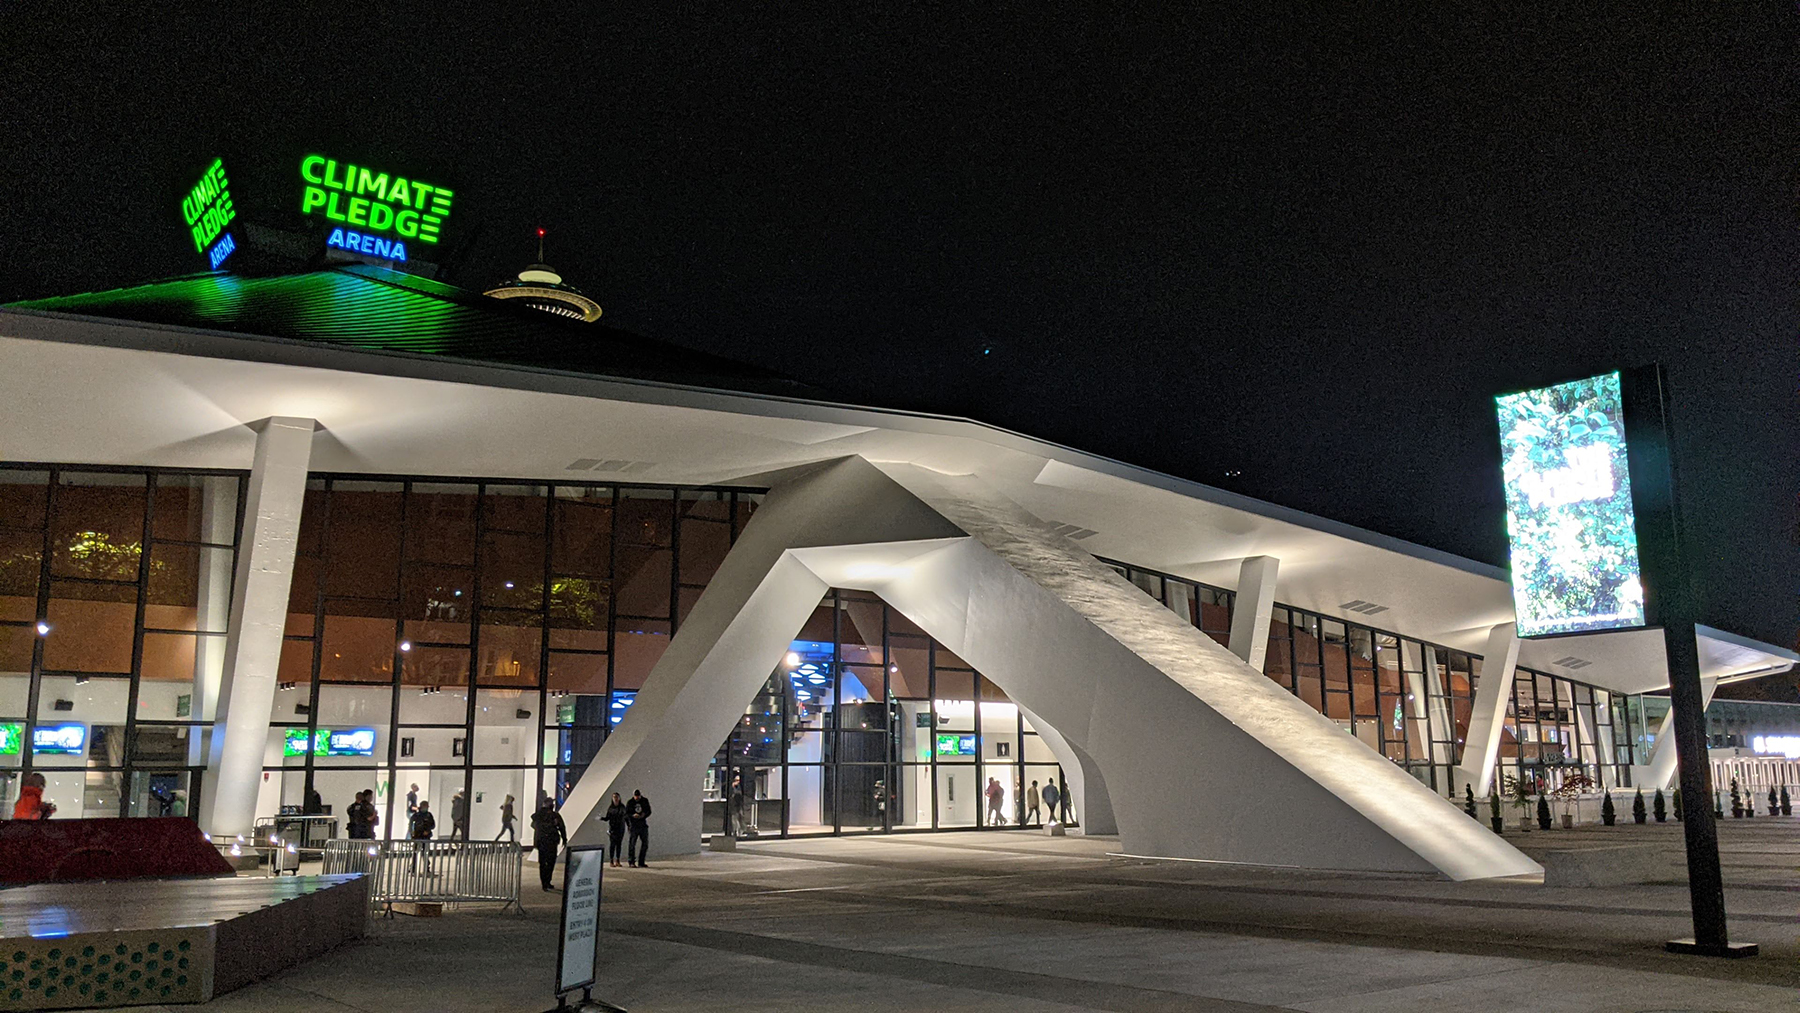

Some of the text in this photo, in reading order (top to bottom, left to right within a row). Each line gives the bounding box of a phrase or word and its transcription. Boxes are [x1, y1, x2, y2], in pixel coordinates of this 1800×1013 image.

[182, 158, 228, 226] CLIMATE
[301, 155, 453, 216] CLIMATE
[302, 186, 441, 243] PLEDGE
[192, 190, 236, 253] PLEDGE
[209, 233, 236, 269] ARENA
[327, 228, 407, 261] ARENA
